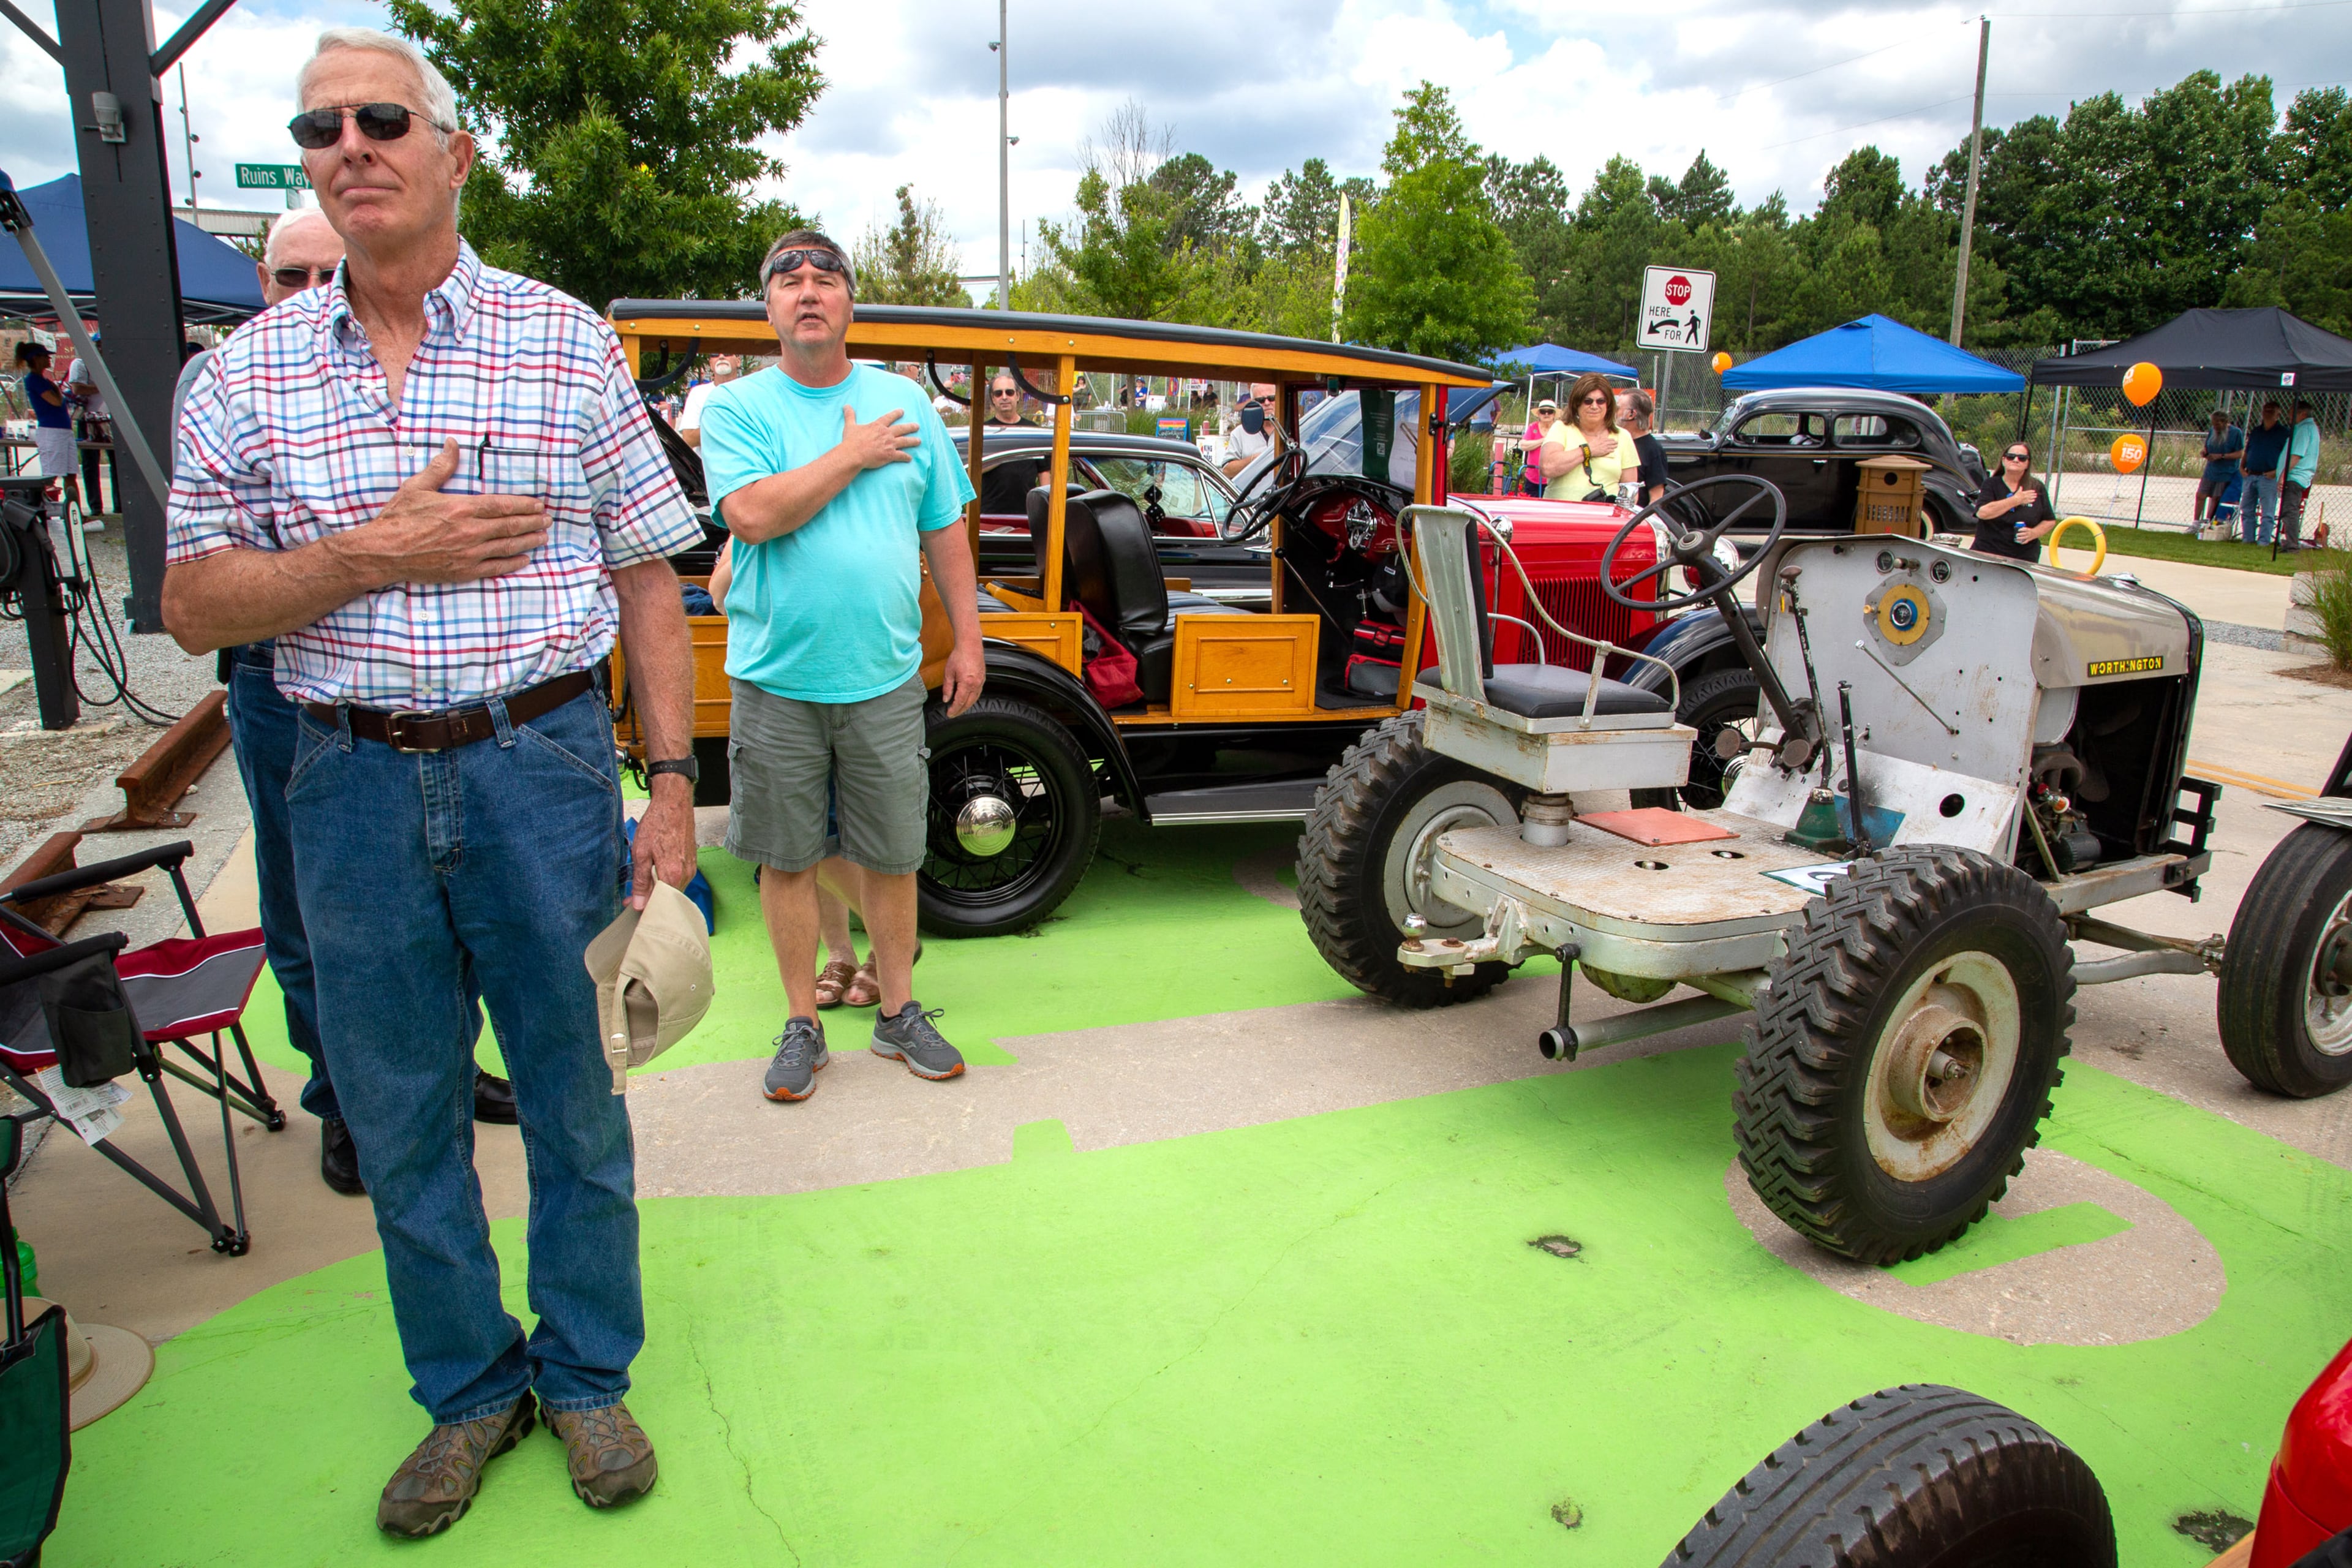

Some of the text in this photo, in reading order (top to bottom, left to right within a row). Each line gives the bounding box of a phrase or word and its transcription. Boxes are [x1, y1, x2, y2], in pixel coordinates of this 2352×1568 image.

[240, 166, 309, 189] Ruins Way
[1666, 284, 1691, 298] STOP
[1648, 305, 1672, 317] HERE
[1664, 330, 1681, 341] FOR
[2121, 447, 2143, 460] 150
[2090, 657, 2162, 676] WORTHINGTON
